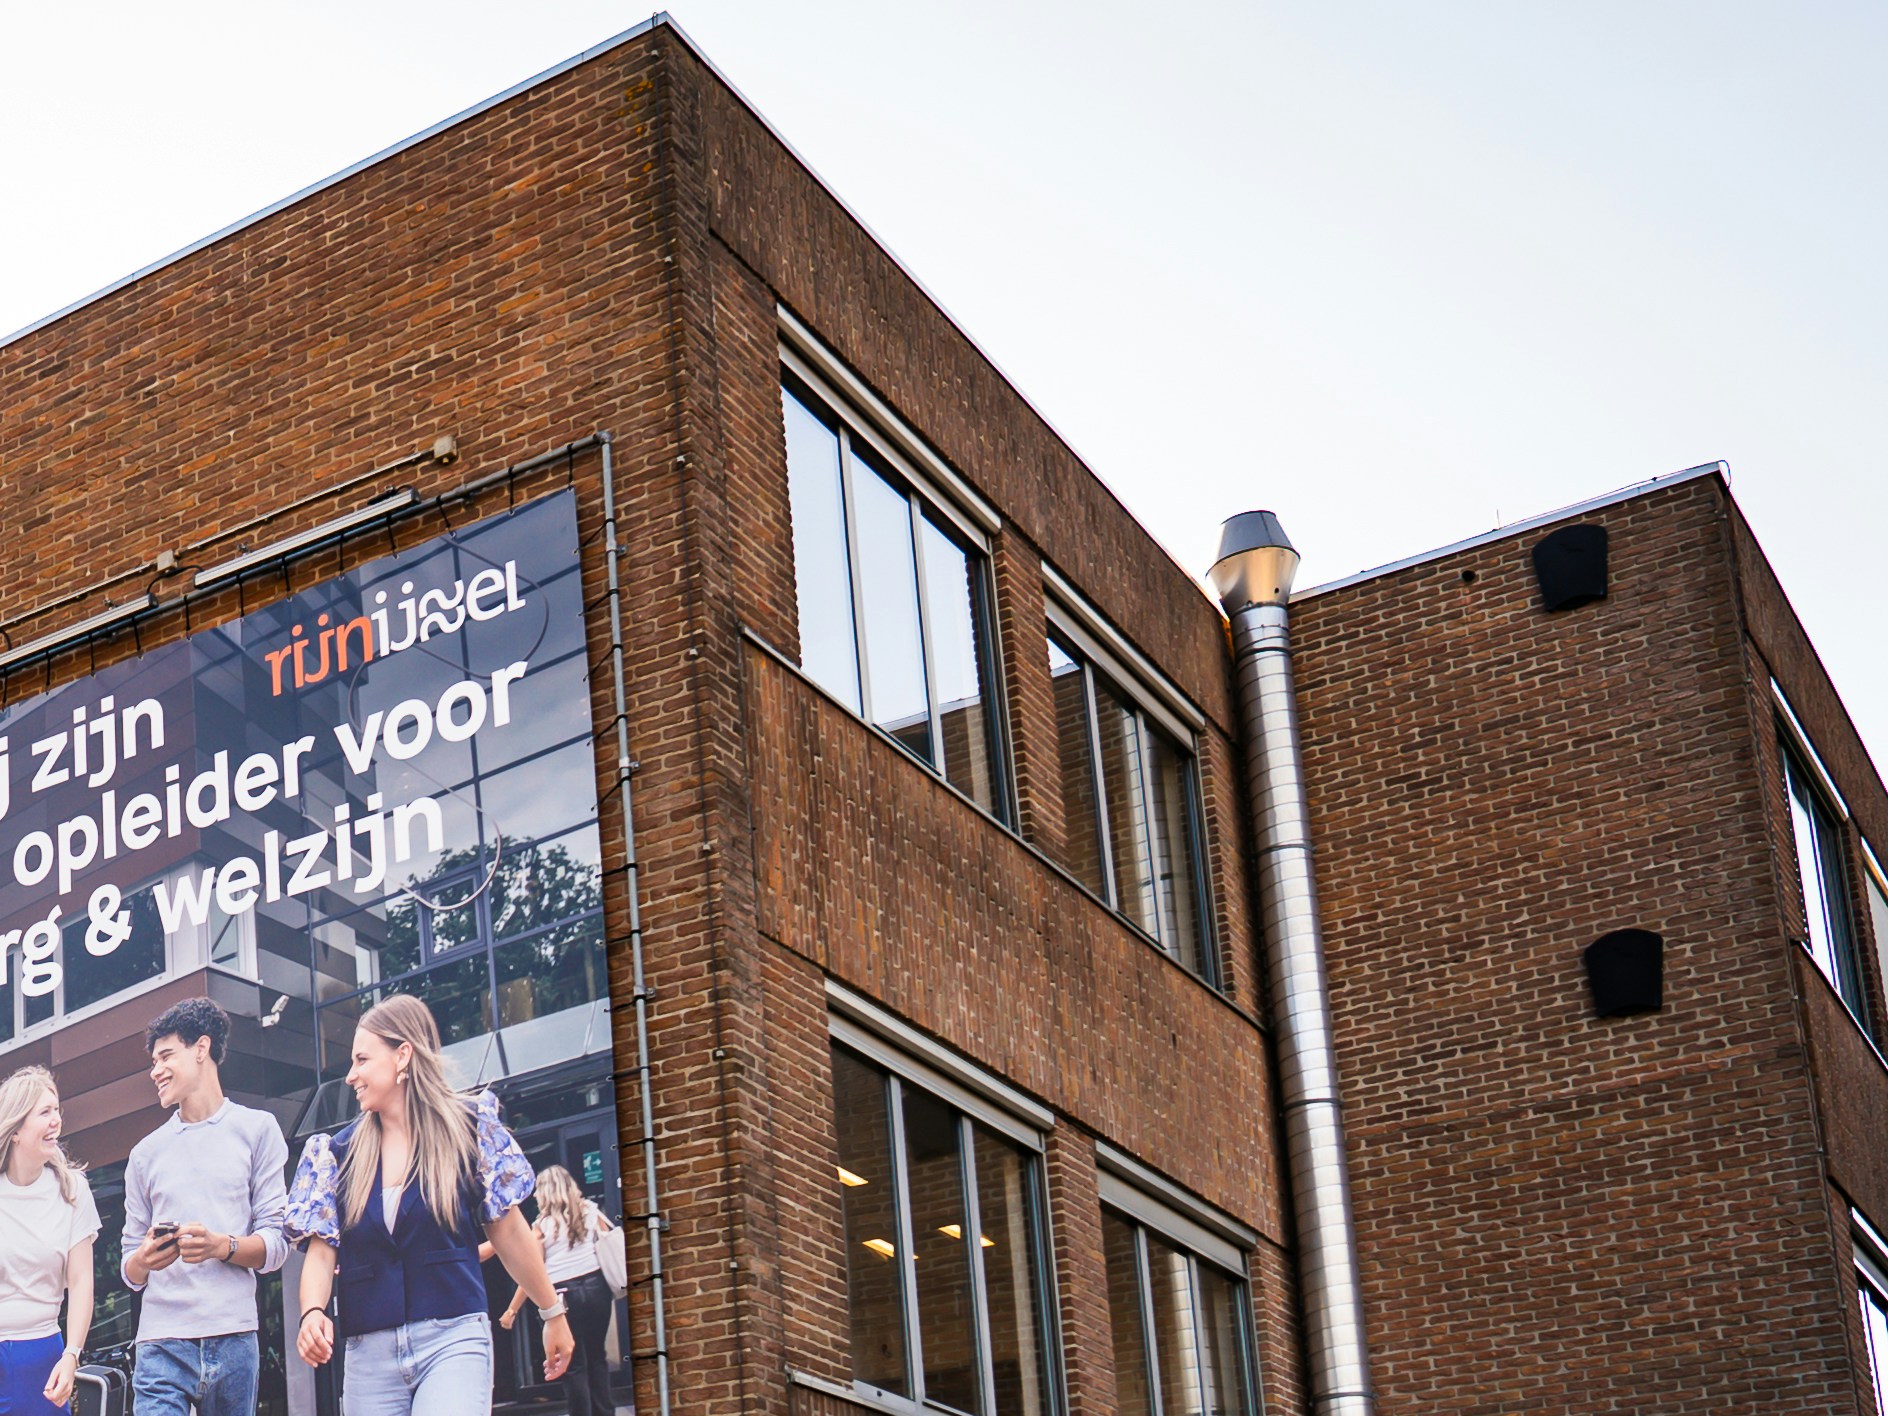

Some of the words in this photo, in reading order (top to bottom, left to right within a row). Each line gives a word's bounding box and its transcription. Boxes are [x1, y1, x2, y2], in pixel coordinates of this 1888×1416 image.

[13, 735, 316, 895] opleider
[334, 661, 528, 775] voor
[31, 695, 165, 793] zijn
[85, 883, 133, 957] &
[154, 791, 445, 936] welzijn
